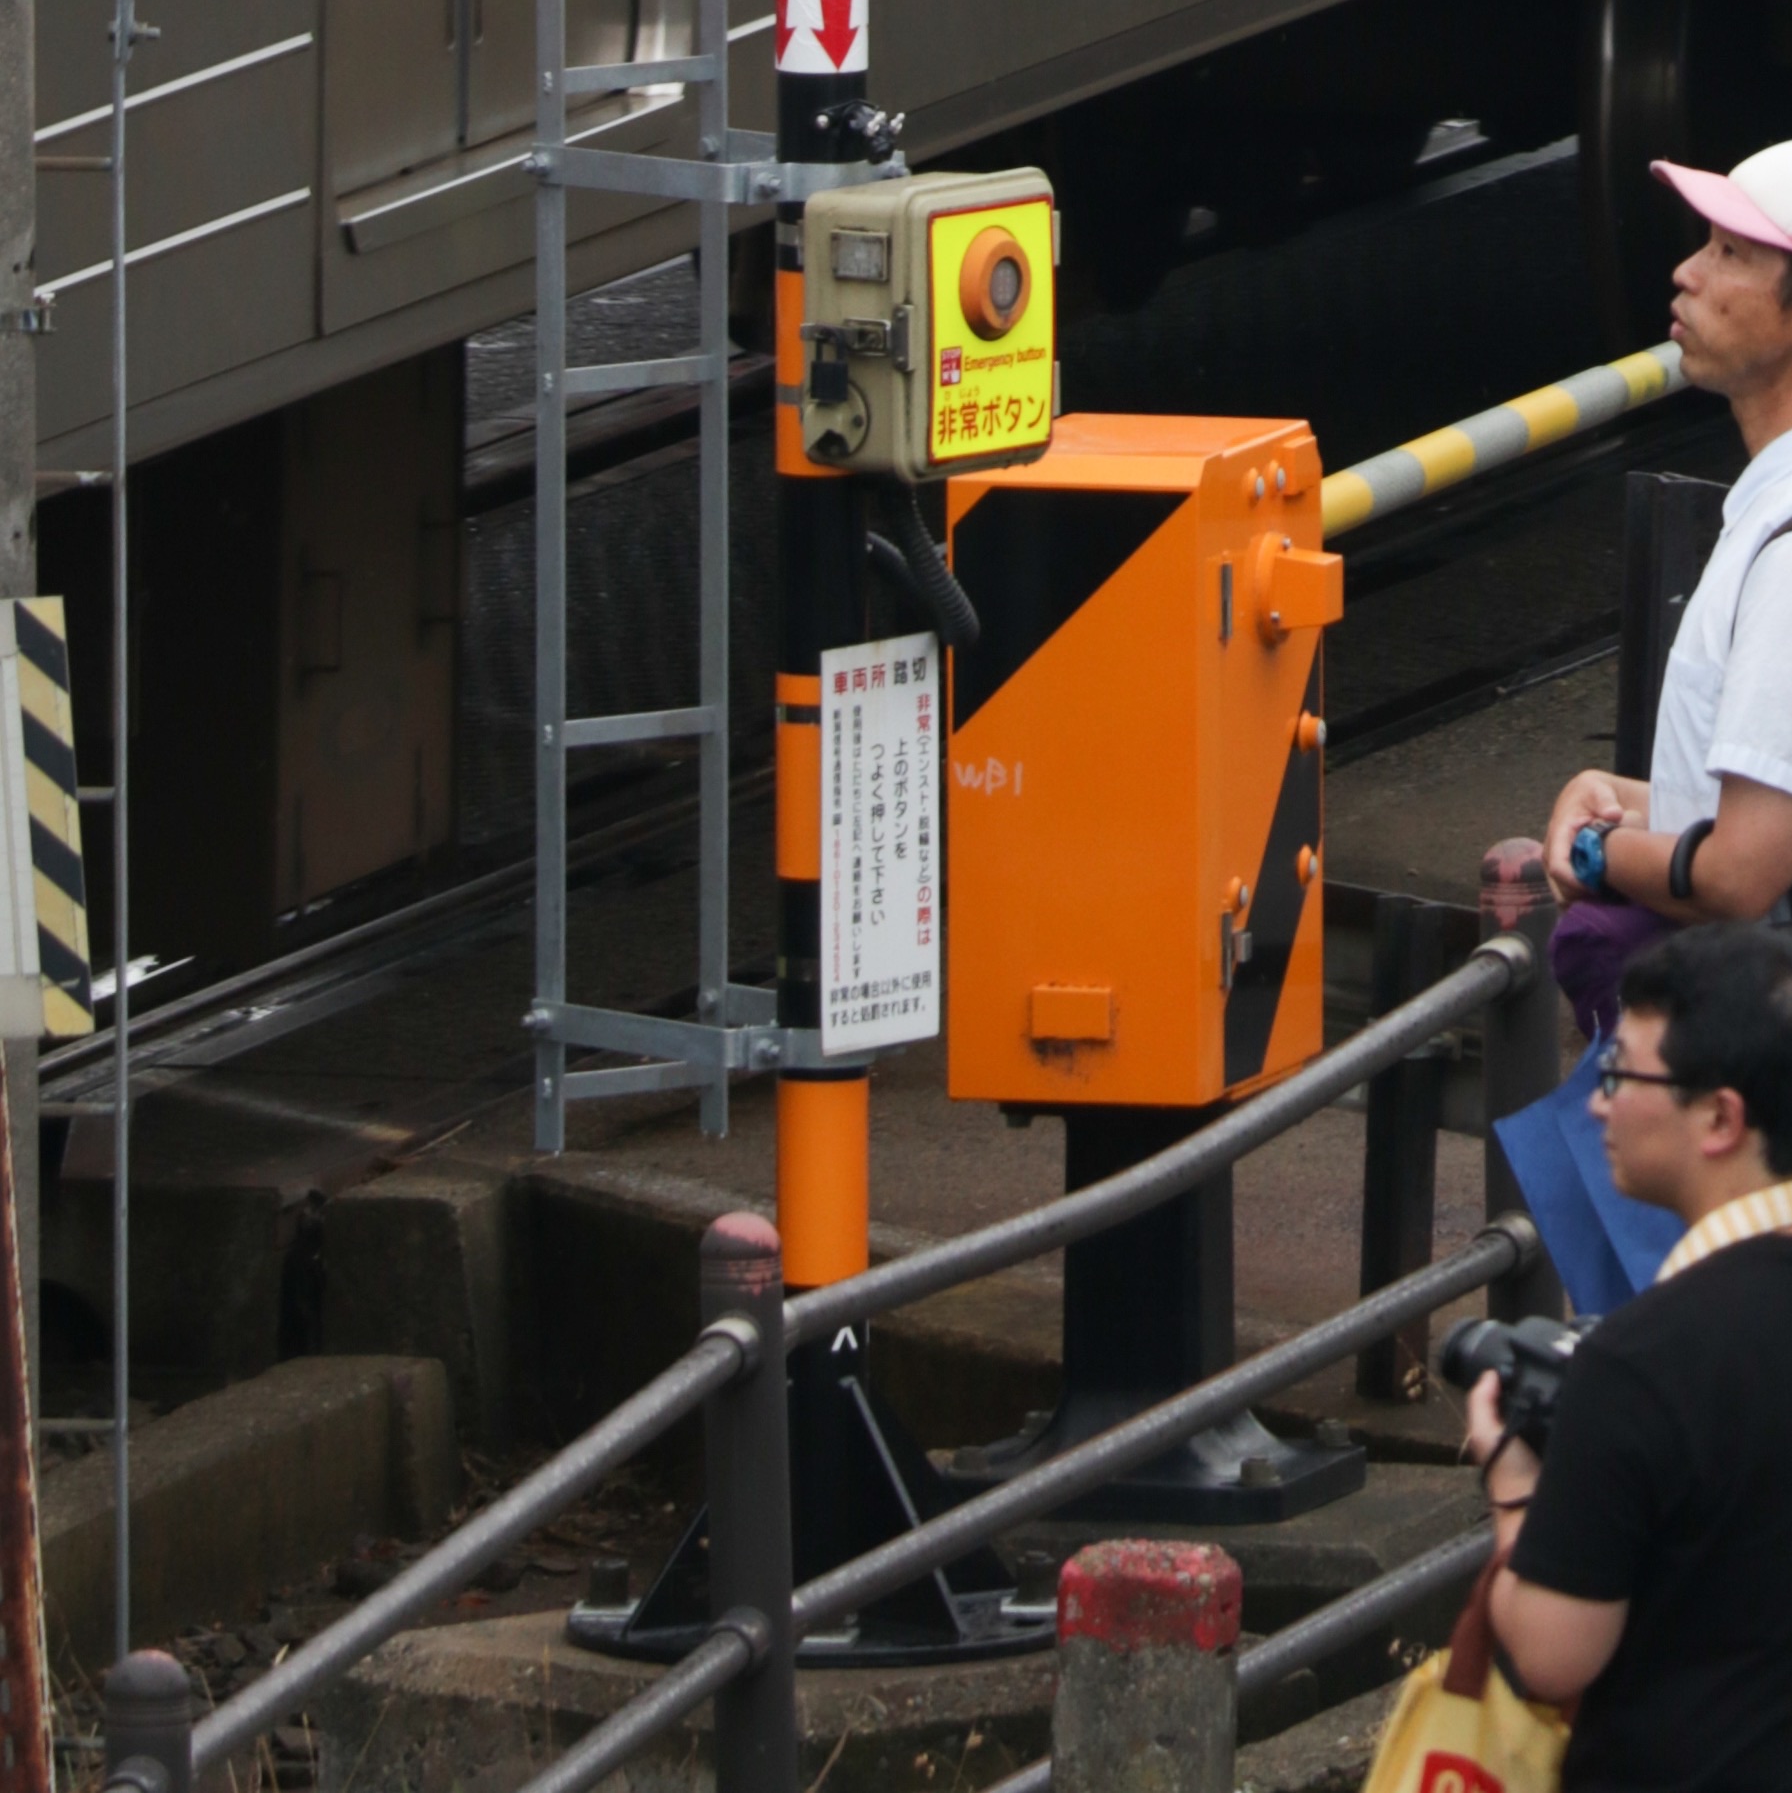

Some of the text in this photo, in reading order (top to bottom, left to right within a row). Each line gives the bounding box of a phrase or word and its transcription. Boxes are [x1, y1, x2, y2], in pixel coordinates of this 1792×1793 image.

[963, 347, 1046, 372] Emergency button
[938, 395, 1046, 445] 非常ボタン
[870, 742, 886, 927] つよく押して下さい
[893, 737, 909, 860] 上のボタンを
